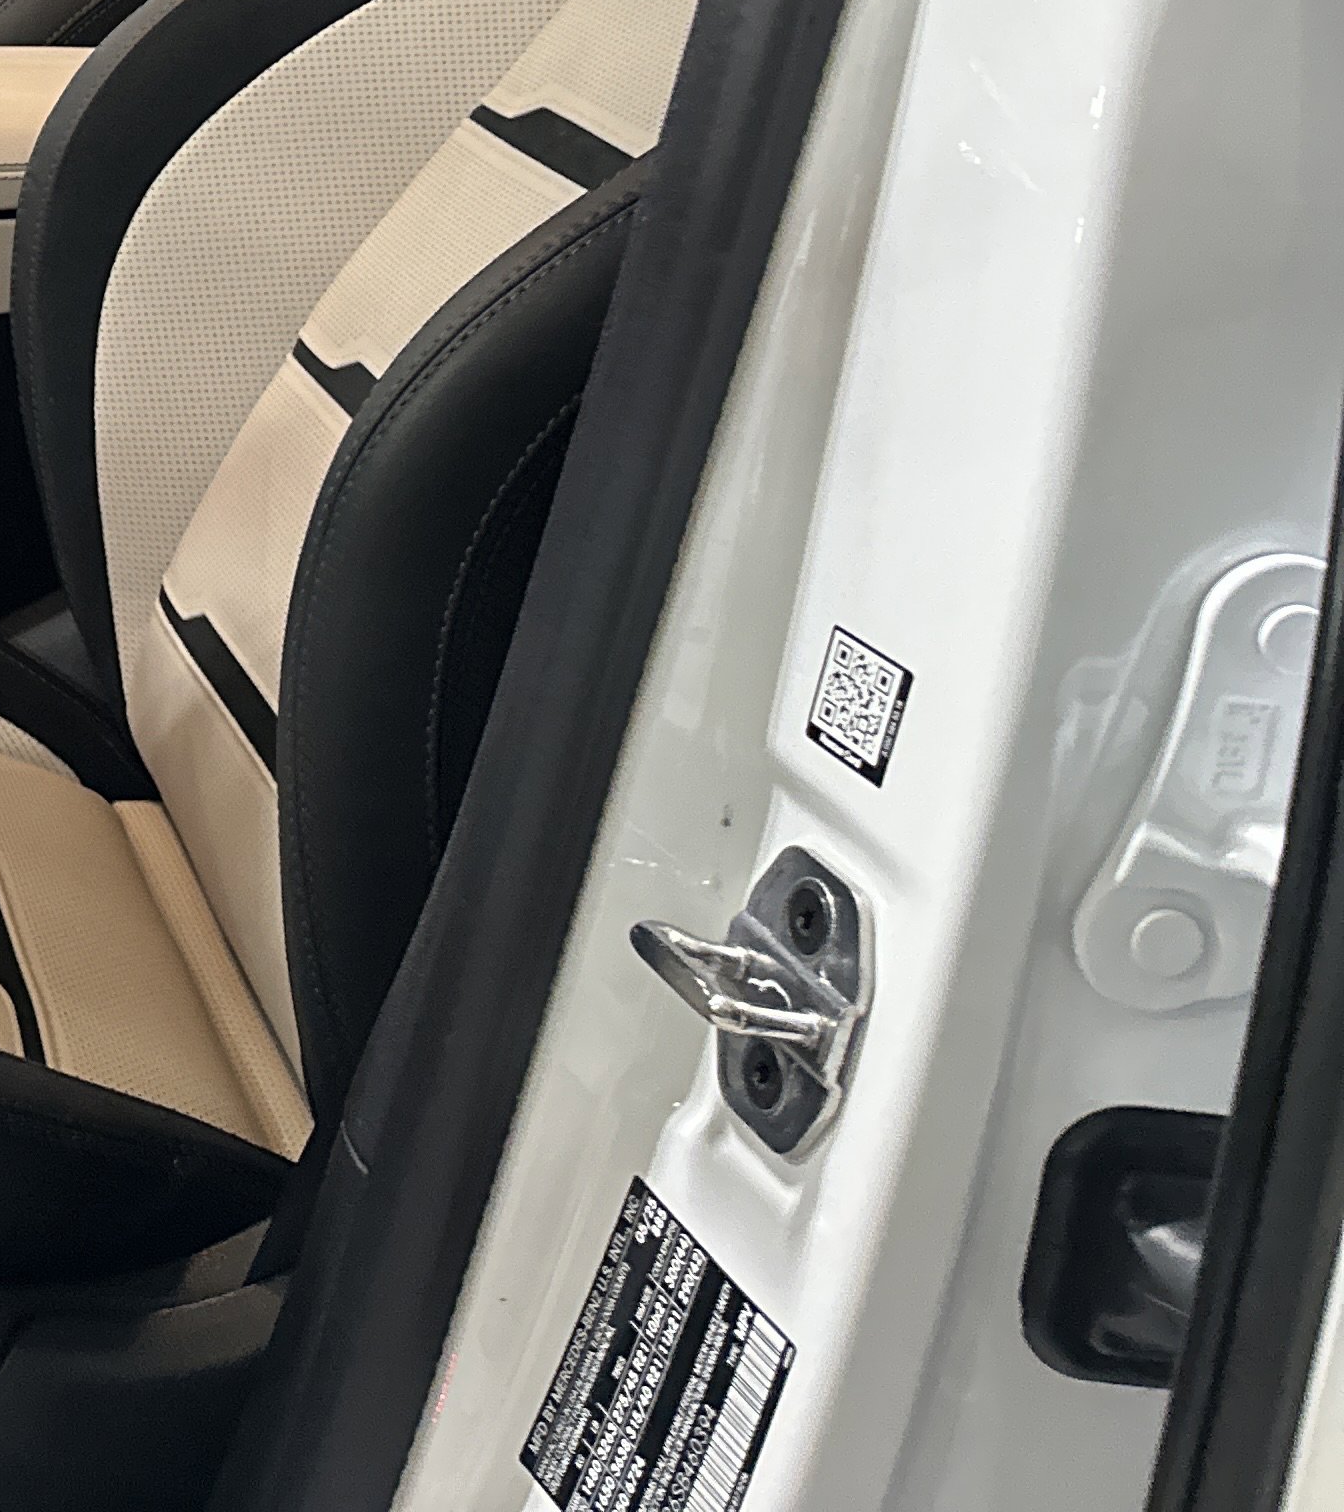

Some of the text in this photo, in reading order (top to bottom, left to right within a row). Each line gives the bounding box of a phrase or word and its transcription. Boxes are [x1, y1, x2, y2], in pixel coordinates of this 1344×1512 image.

[733, 1303, 753, 1339] MPV
[529, 1421, 547, 1454] MFD
[543, 1401, 556, 1421] BY
[551, 1290, 601, 1401] MERCEDES-BENZ
